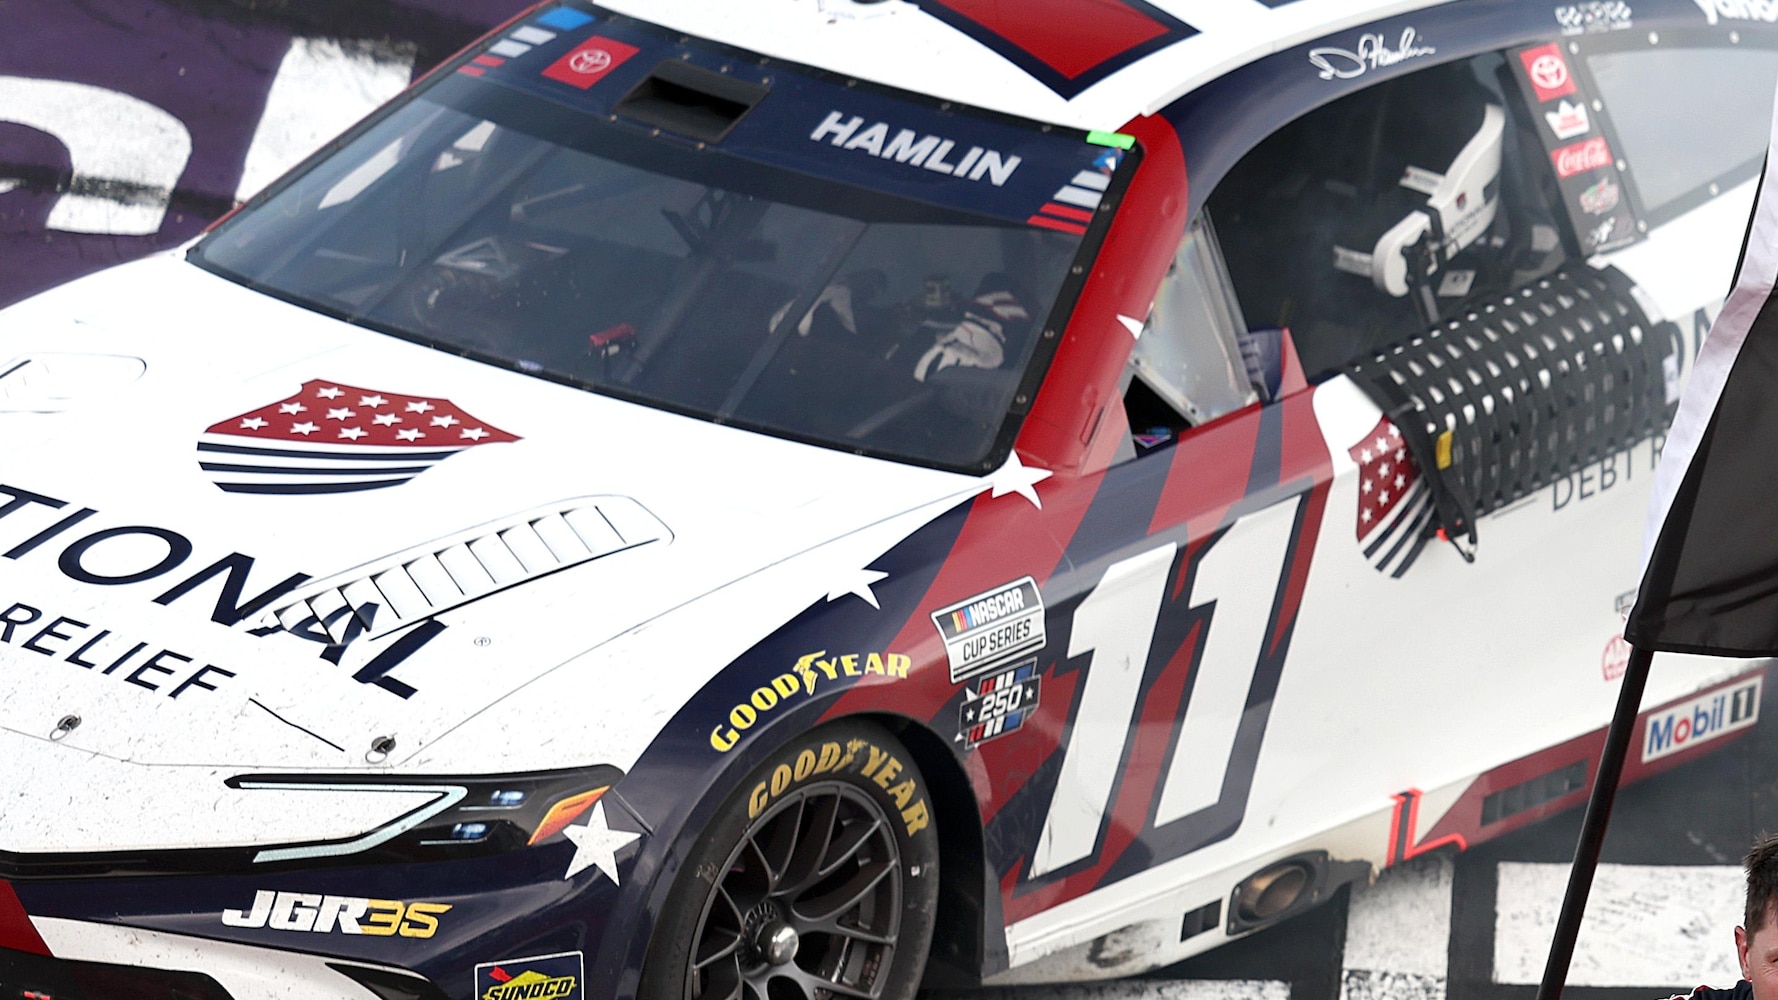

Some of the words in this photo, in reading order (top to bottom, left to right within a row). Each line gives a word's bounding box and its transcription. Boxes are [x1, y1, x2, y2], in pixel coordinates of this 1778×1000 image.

[810, 110, 1022, 187] HAMLIN
[963, 634, 988, 662] CUP
[989, 618, 1032, 652] SERIES
[968, 588, 1025, 627] NASCAR
[0, 602, 237, 700] RELIEF
[1028, 494, 1302, 881] 11
[710, 650, 912, 752] GOODYEAR
[978, 684, 1024, 723] 250
[1647, 695, 1727, 755] Mobil
[1729, 684, 1758, 725] 1
[748, 738, 930, 837] GOODYEAR
